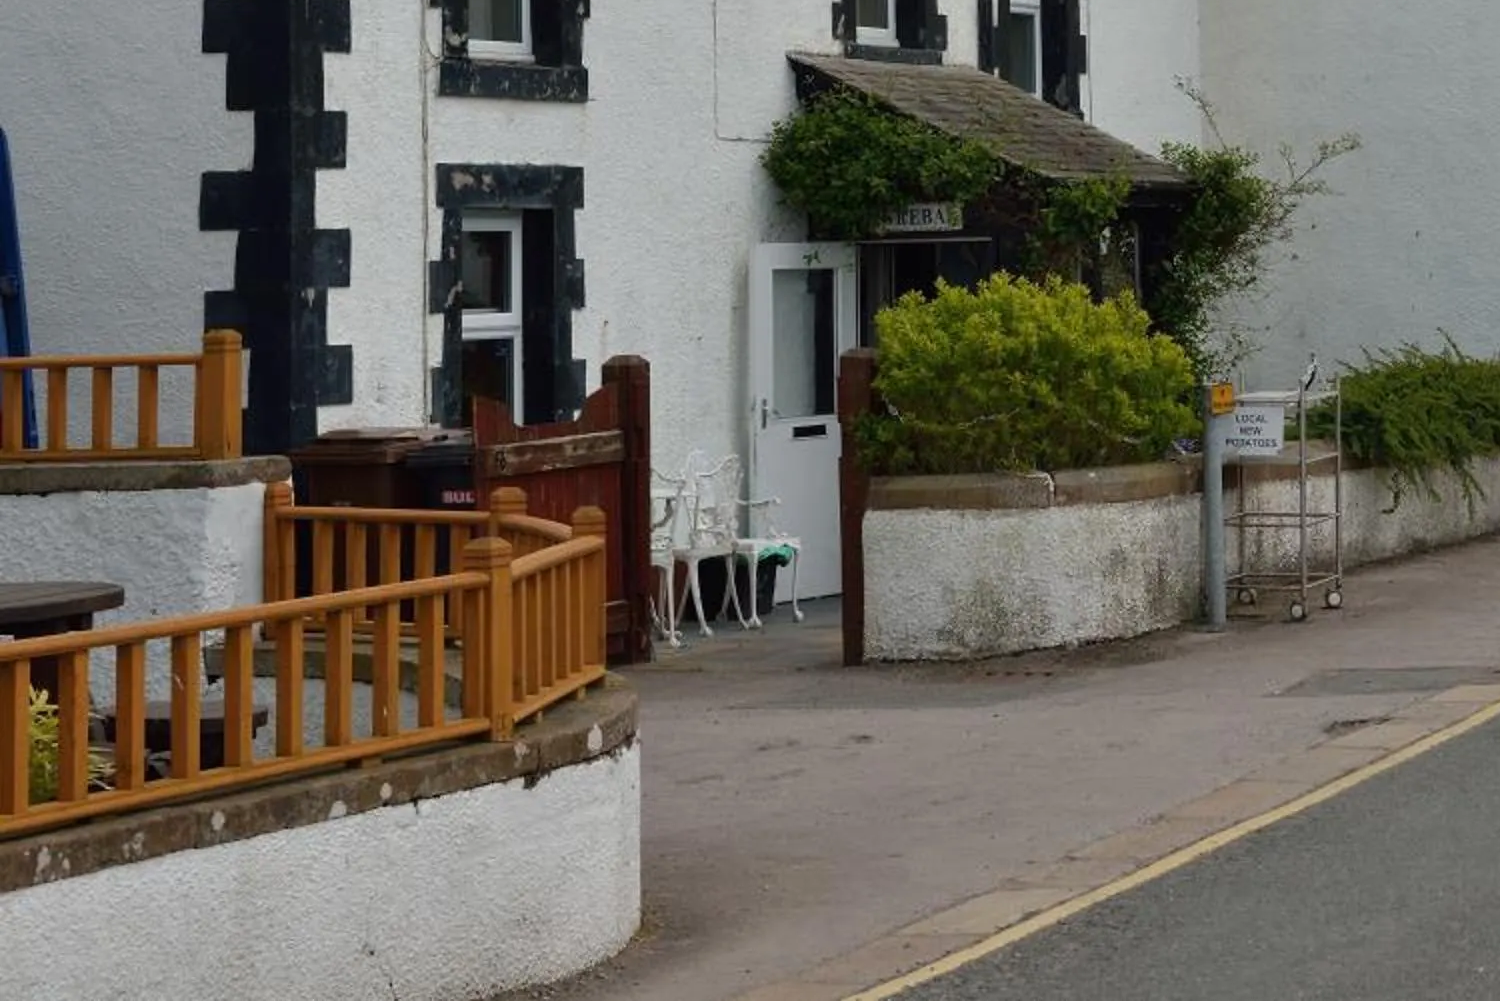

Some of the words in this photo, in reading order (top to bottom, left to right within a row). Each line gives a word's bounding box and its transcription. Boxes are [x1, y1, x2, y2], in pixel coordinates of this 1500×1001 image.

[1235, 414, 1268, 424] LOCAL
[1239, 426, 1264, 436] NEW
[1225, 438, 1278, 448] POTATOES
